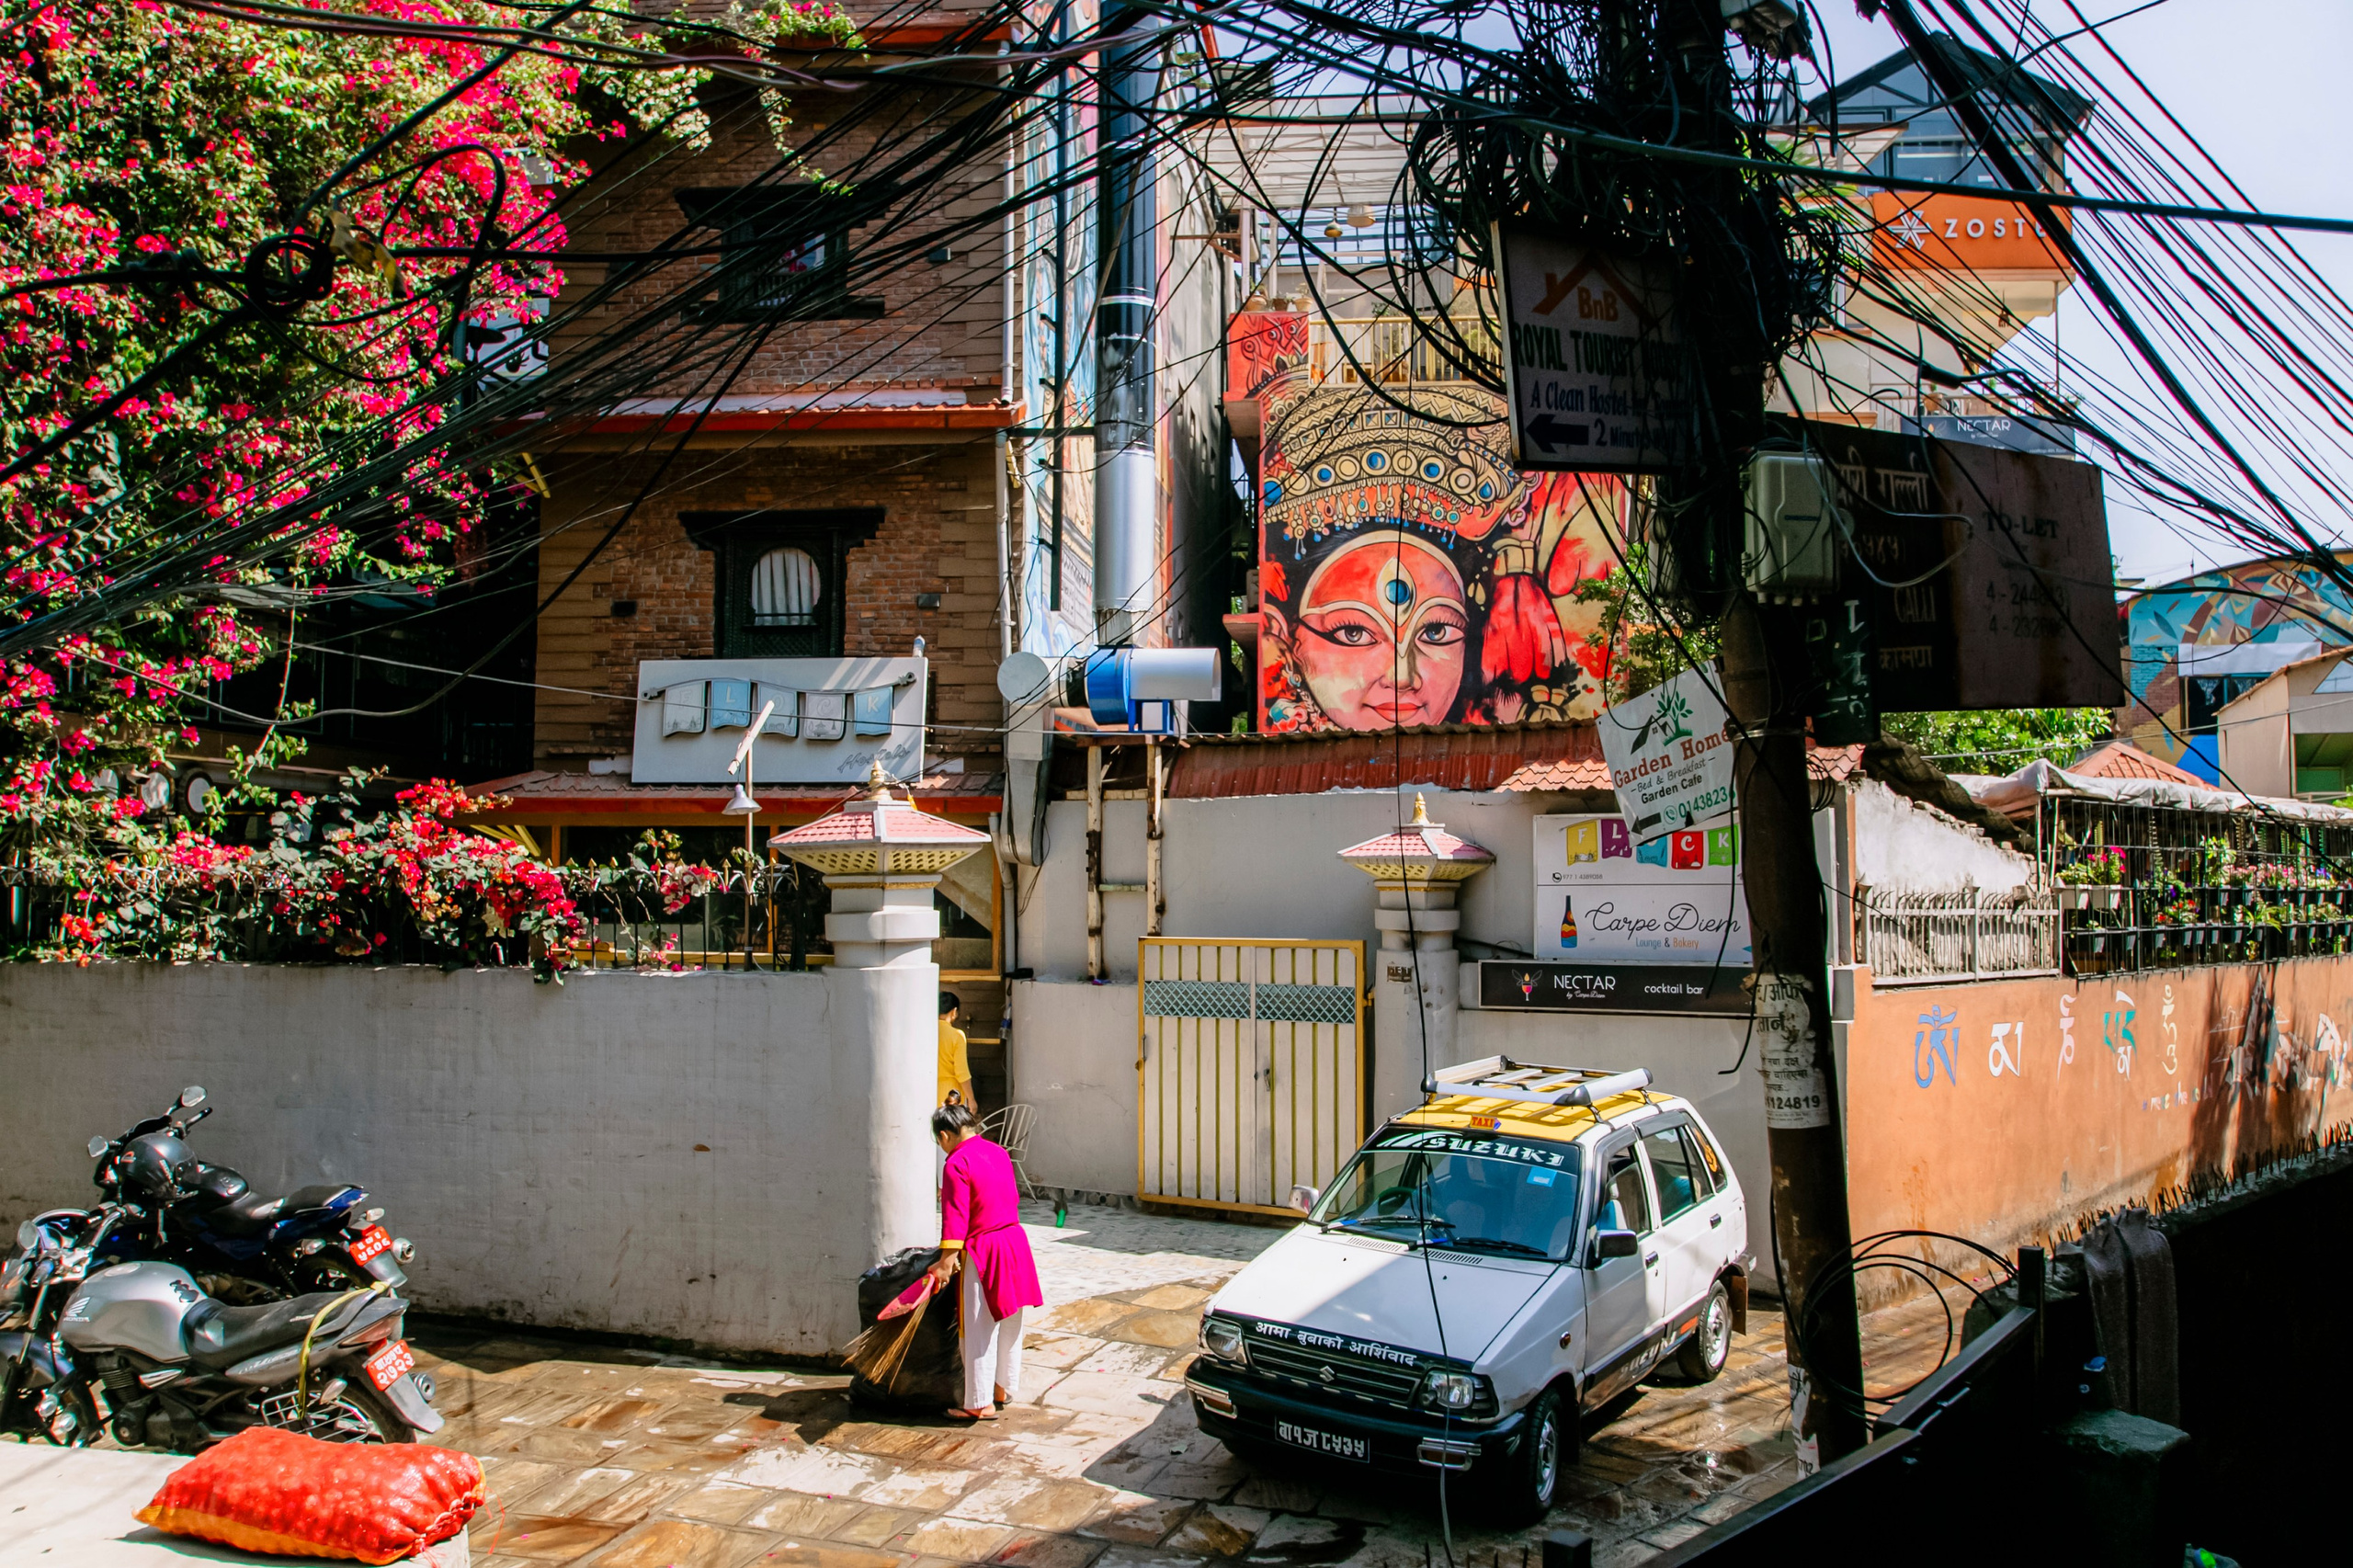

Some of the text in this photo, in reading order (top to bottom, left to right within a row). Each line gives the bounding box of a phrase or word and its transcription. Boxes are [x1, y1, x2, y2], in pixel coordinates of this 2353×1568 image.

[1578, 287, 1619, 322] BnB
[1512, 322, 1568, 372] ROYAL
[1570, 330, 1635, 378] TOURIST
[1530, 381, 1541, 409] A
[1546, 381, 1586, 413] Clean
[1589, 384, 1629, 417] Hostel
[1594, 417, 1608, 447] 2
[1957, 419, 2012, 433] NECTAR
[1983, 511, 2060, 540] TO-LET
[837, 744, 911, 775] Hostels
[1614, 727, 1732, 789] Garden Home
[1637, 757, 1707, 793] Bed & Breakfast
[1641, 773, 1703, 805] Garden Cafe
[1585, 902, 1741, 940] Carpe Diem
[1635, 936, 1700, 950] Lounge & Bakery
[1553, 974, 1704, 995] NECTAR cocktail bar
[1566, 991, 1574, 1000] by
[1472, 1115, 1495, 1129] TAXI
[1424, 1137, 1566, 1168] SUZUKI
[1256, 1322, 1292, 1339] आमा
[1297, 1330, 1345, 1351] बुबाको
